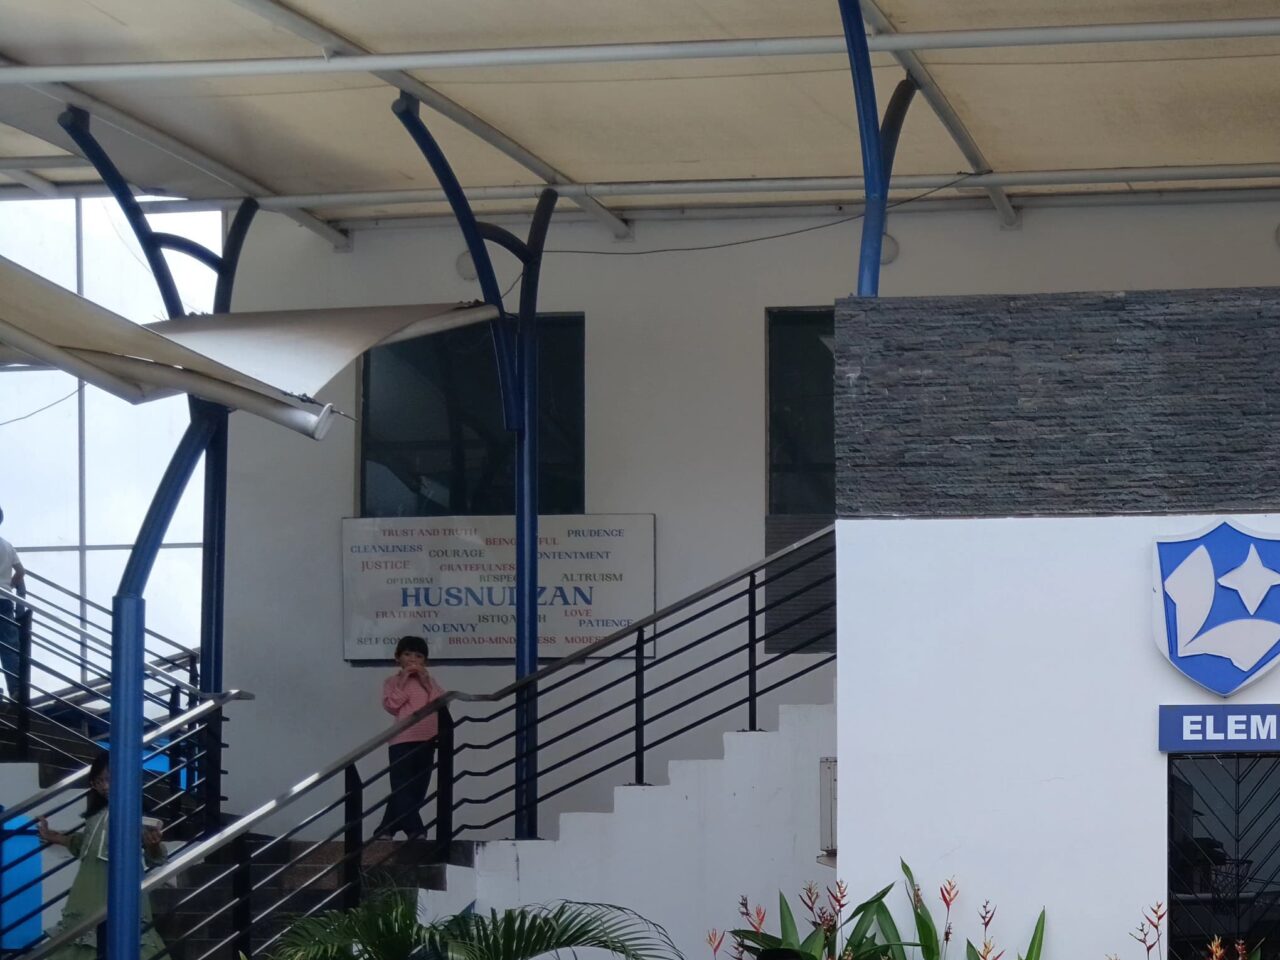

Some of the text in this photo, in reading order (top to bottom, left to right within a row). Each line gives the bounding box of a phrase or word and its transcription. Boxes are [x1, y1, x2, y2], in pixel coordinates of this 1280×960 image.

[382, 528, 478, 537] TRUST AND TRUTH
[567, 529, 624, 538] PRUDENCE
[350, 545, 423, 554] CLEANLINESS
[428, 549, 485, 558] COURAGE
[537, 551, 612, 560] ONTENTMENT
[361, 560, 411, 572] JUSTICE
[439, 563, 516, 572] GRATEFULNES
[560, 573, 624, 582] ALTRUISM
[401, 586, 594, 608] HUSNUZAN
[375, 610, 440, 619] FRATERNITY
[564, 609, 592, 617] LOVE
[422, 623, 478, 633] NO ENVY
[579, 619, 634, 628] PATIENCE
[357, 637, 380, 645] SELF
